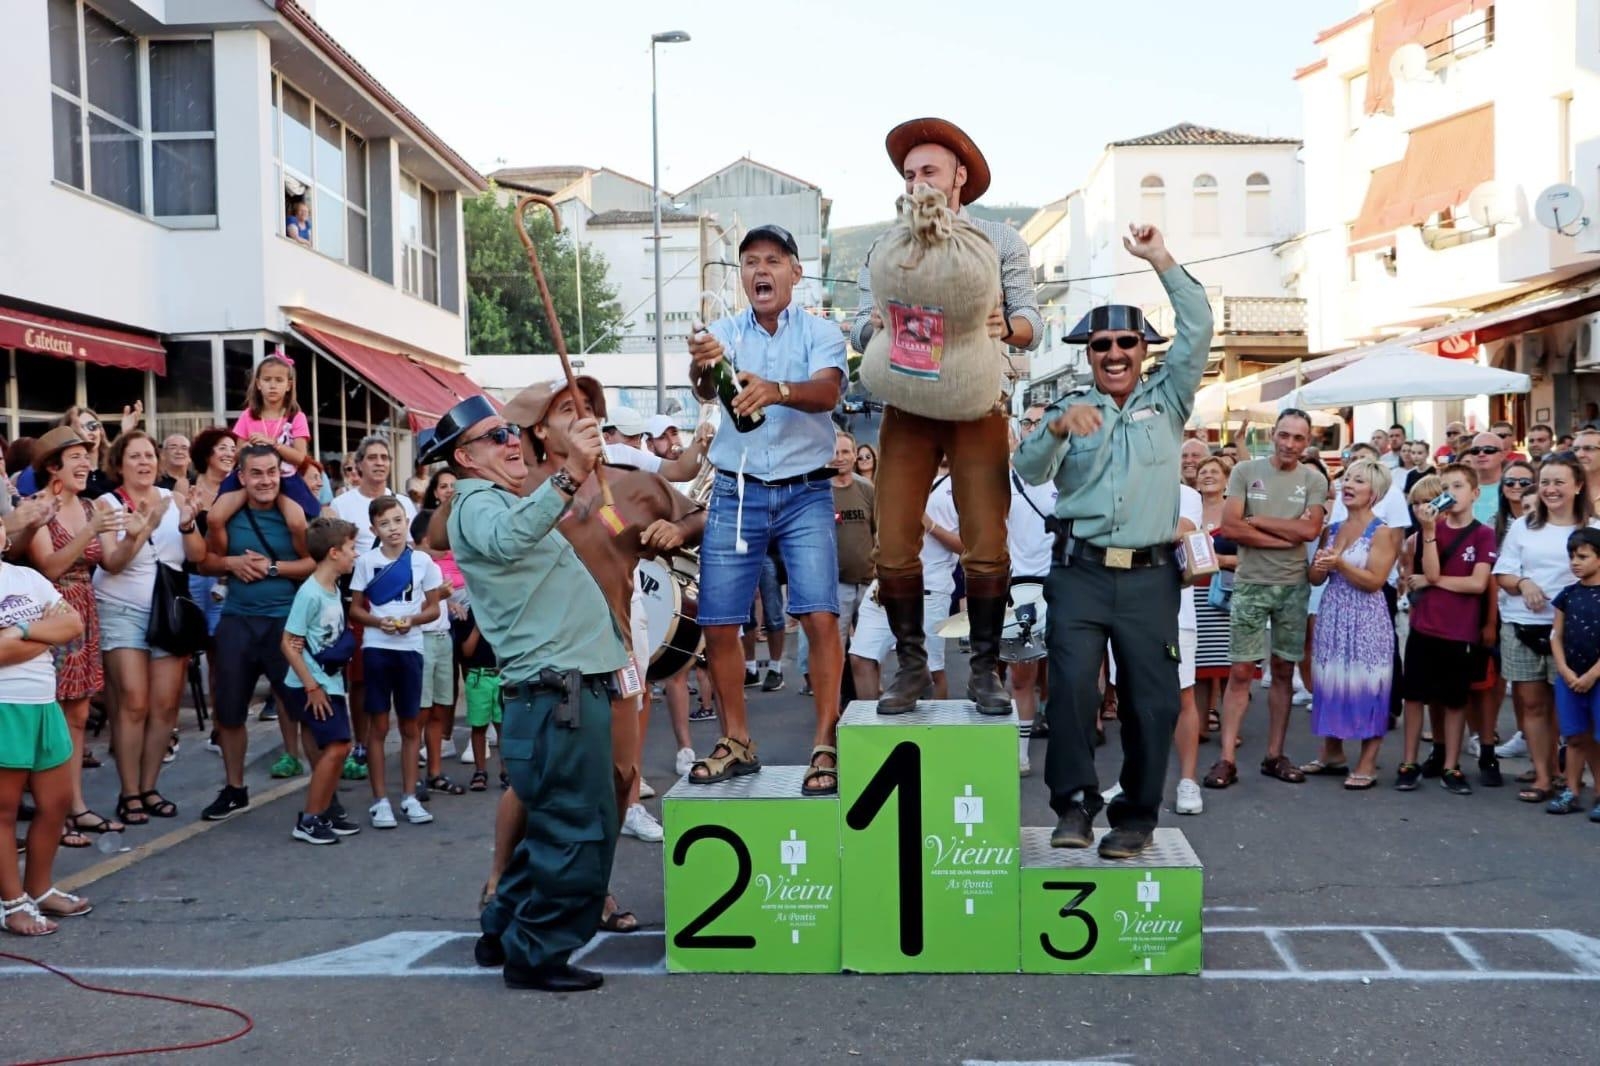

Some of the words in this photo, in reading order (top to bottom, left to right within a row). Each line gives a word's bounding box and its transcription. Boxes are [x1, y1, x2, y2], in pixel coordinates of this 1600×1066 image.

[846, 741, 923, 956] 1
[925, 835, 1014, 868] Vieiru
[673, 825, 756, 949] 2
[755, 874, 833, 902] Vieiru
[1040, 882, 1098, 960] 3
[1113, 910, 1183, 935] Vieiru
